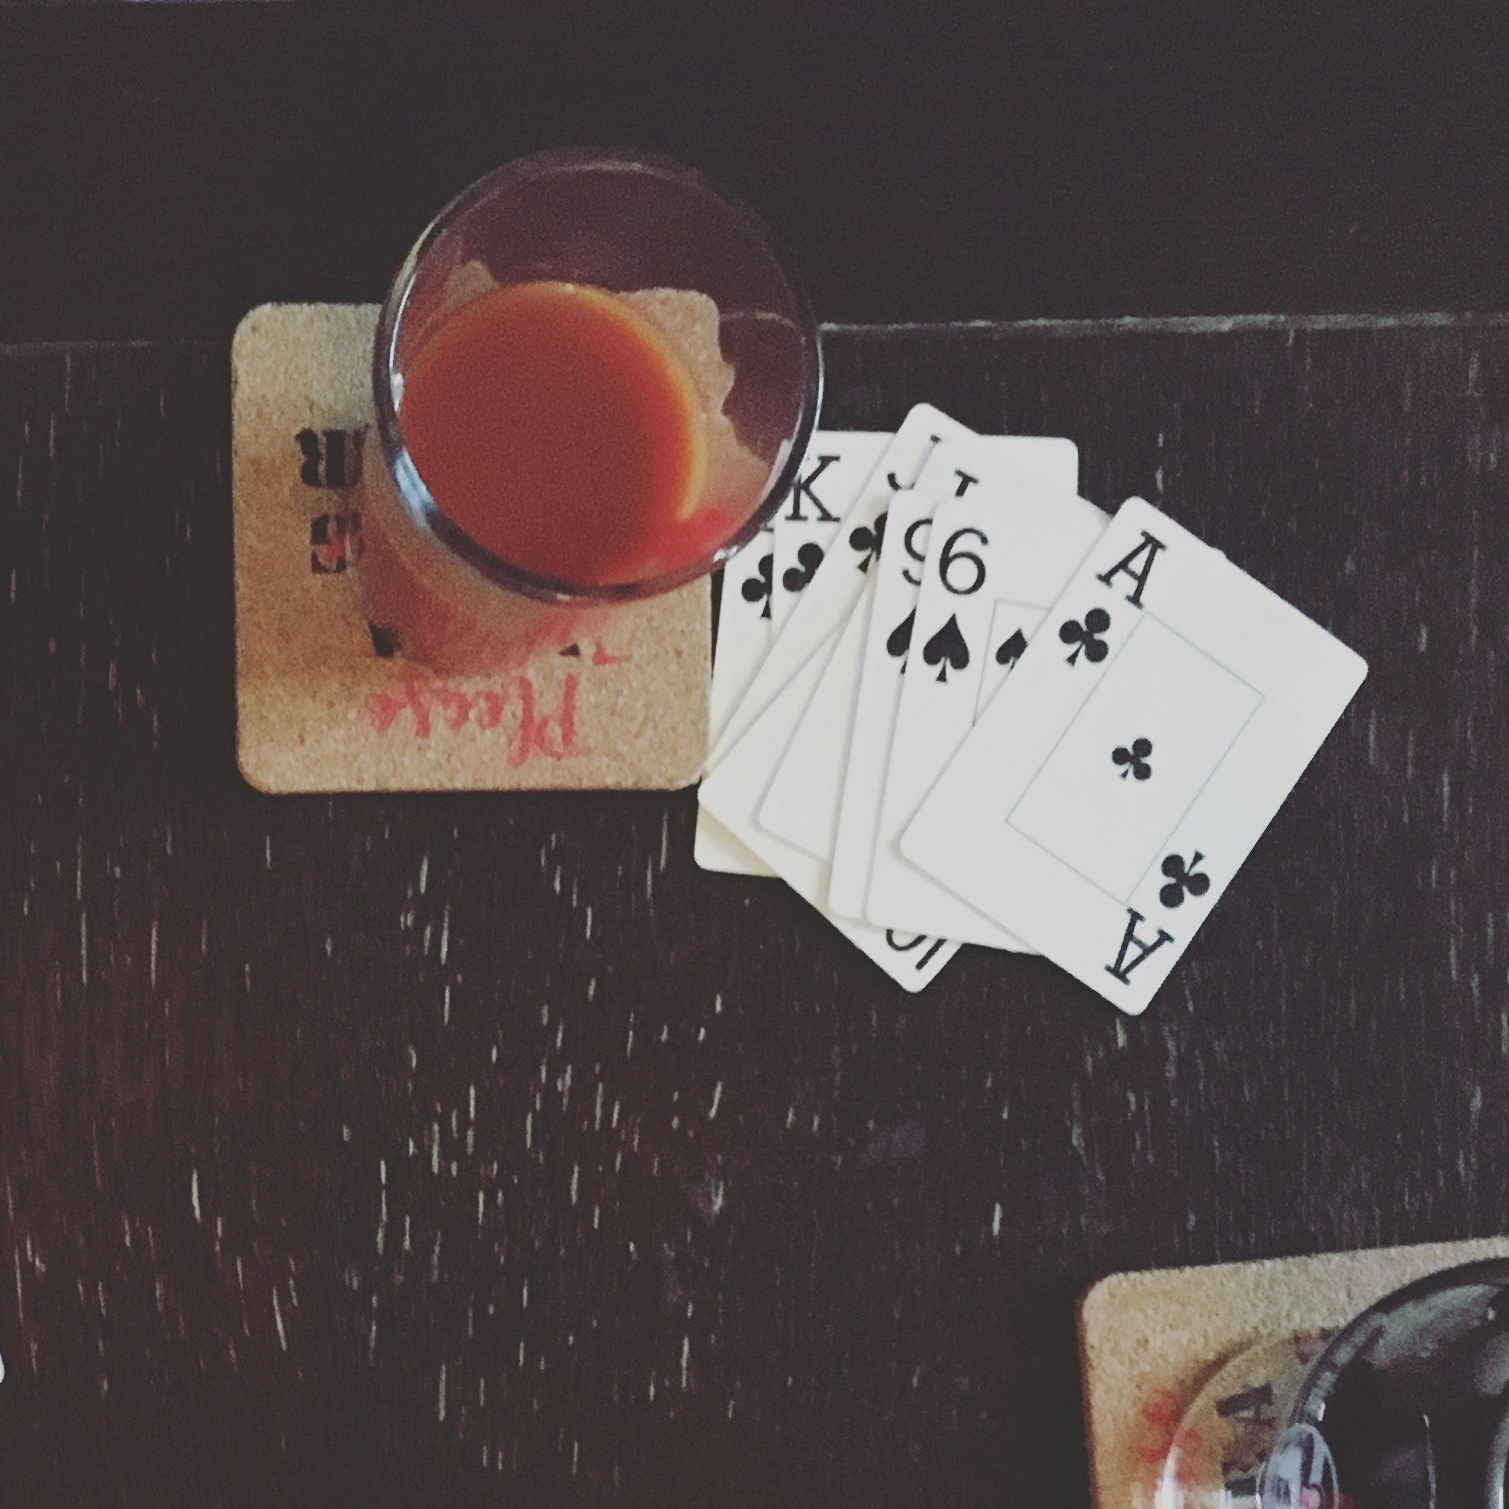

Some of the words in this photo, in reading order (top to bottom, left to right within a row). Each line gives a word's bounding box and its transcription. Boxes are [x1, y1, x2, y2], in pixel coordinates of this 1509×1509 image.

[785, 455, 841, 522] K
[939, 527, 989, 595] 6
[1096, 529, 1168, 610] A
[1104, 907, 1175, 985] A
